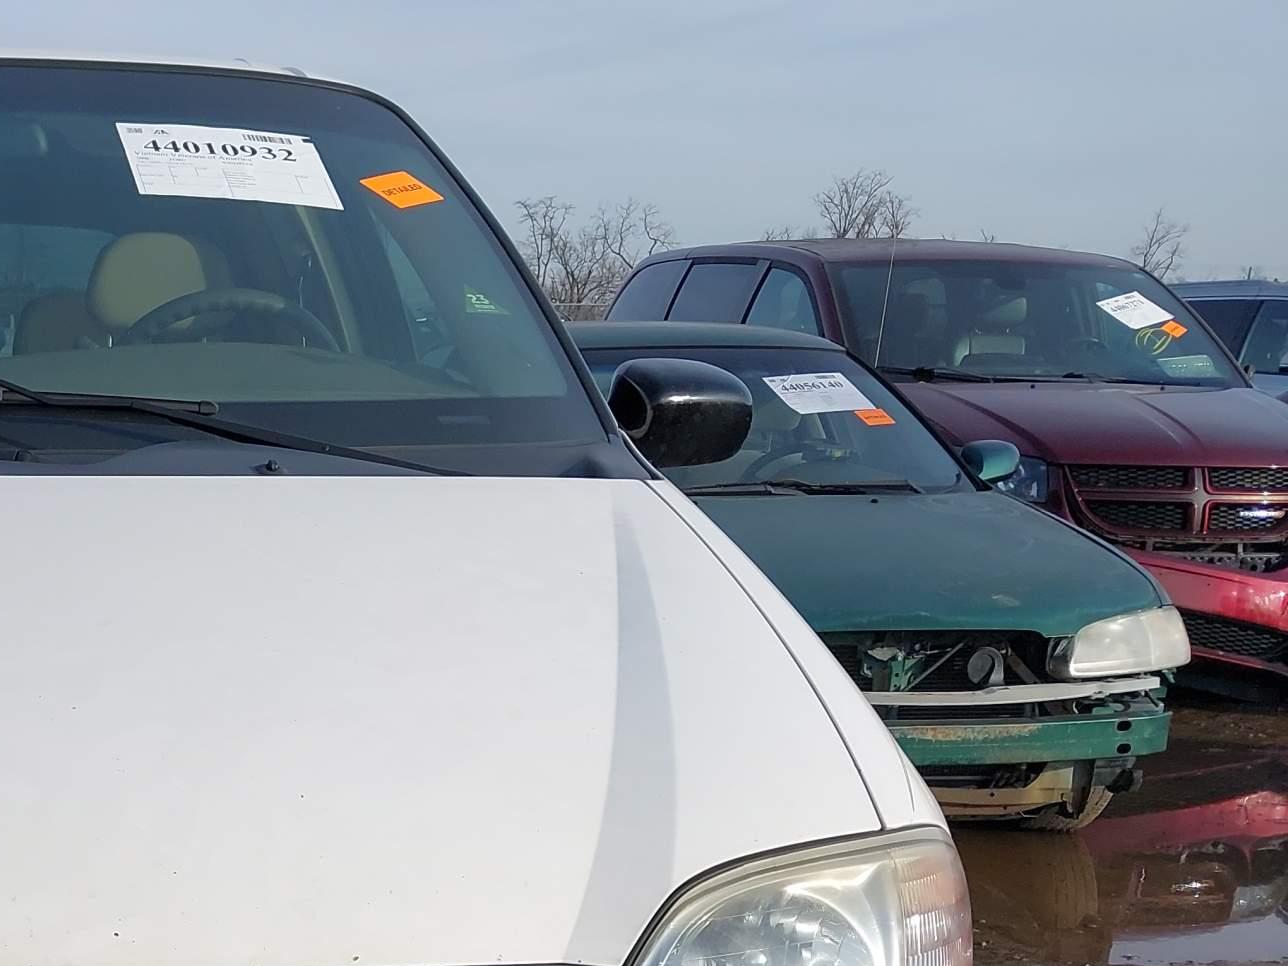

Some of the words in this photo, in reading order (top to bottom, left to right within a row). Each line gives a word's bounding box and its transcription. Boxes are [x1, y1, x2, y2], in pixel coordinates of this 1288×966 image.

[143, 139, 297, 162] 44010932
[381, 183, 423, 196] DETAILED
[781, 380, 844, 392] 44056140
